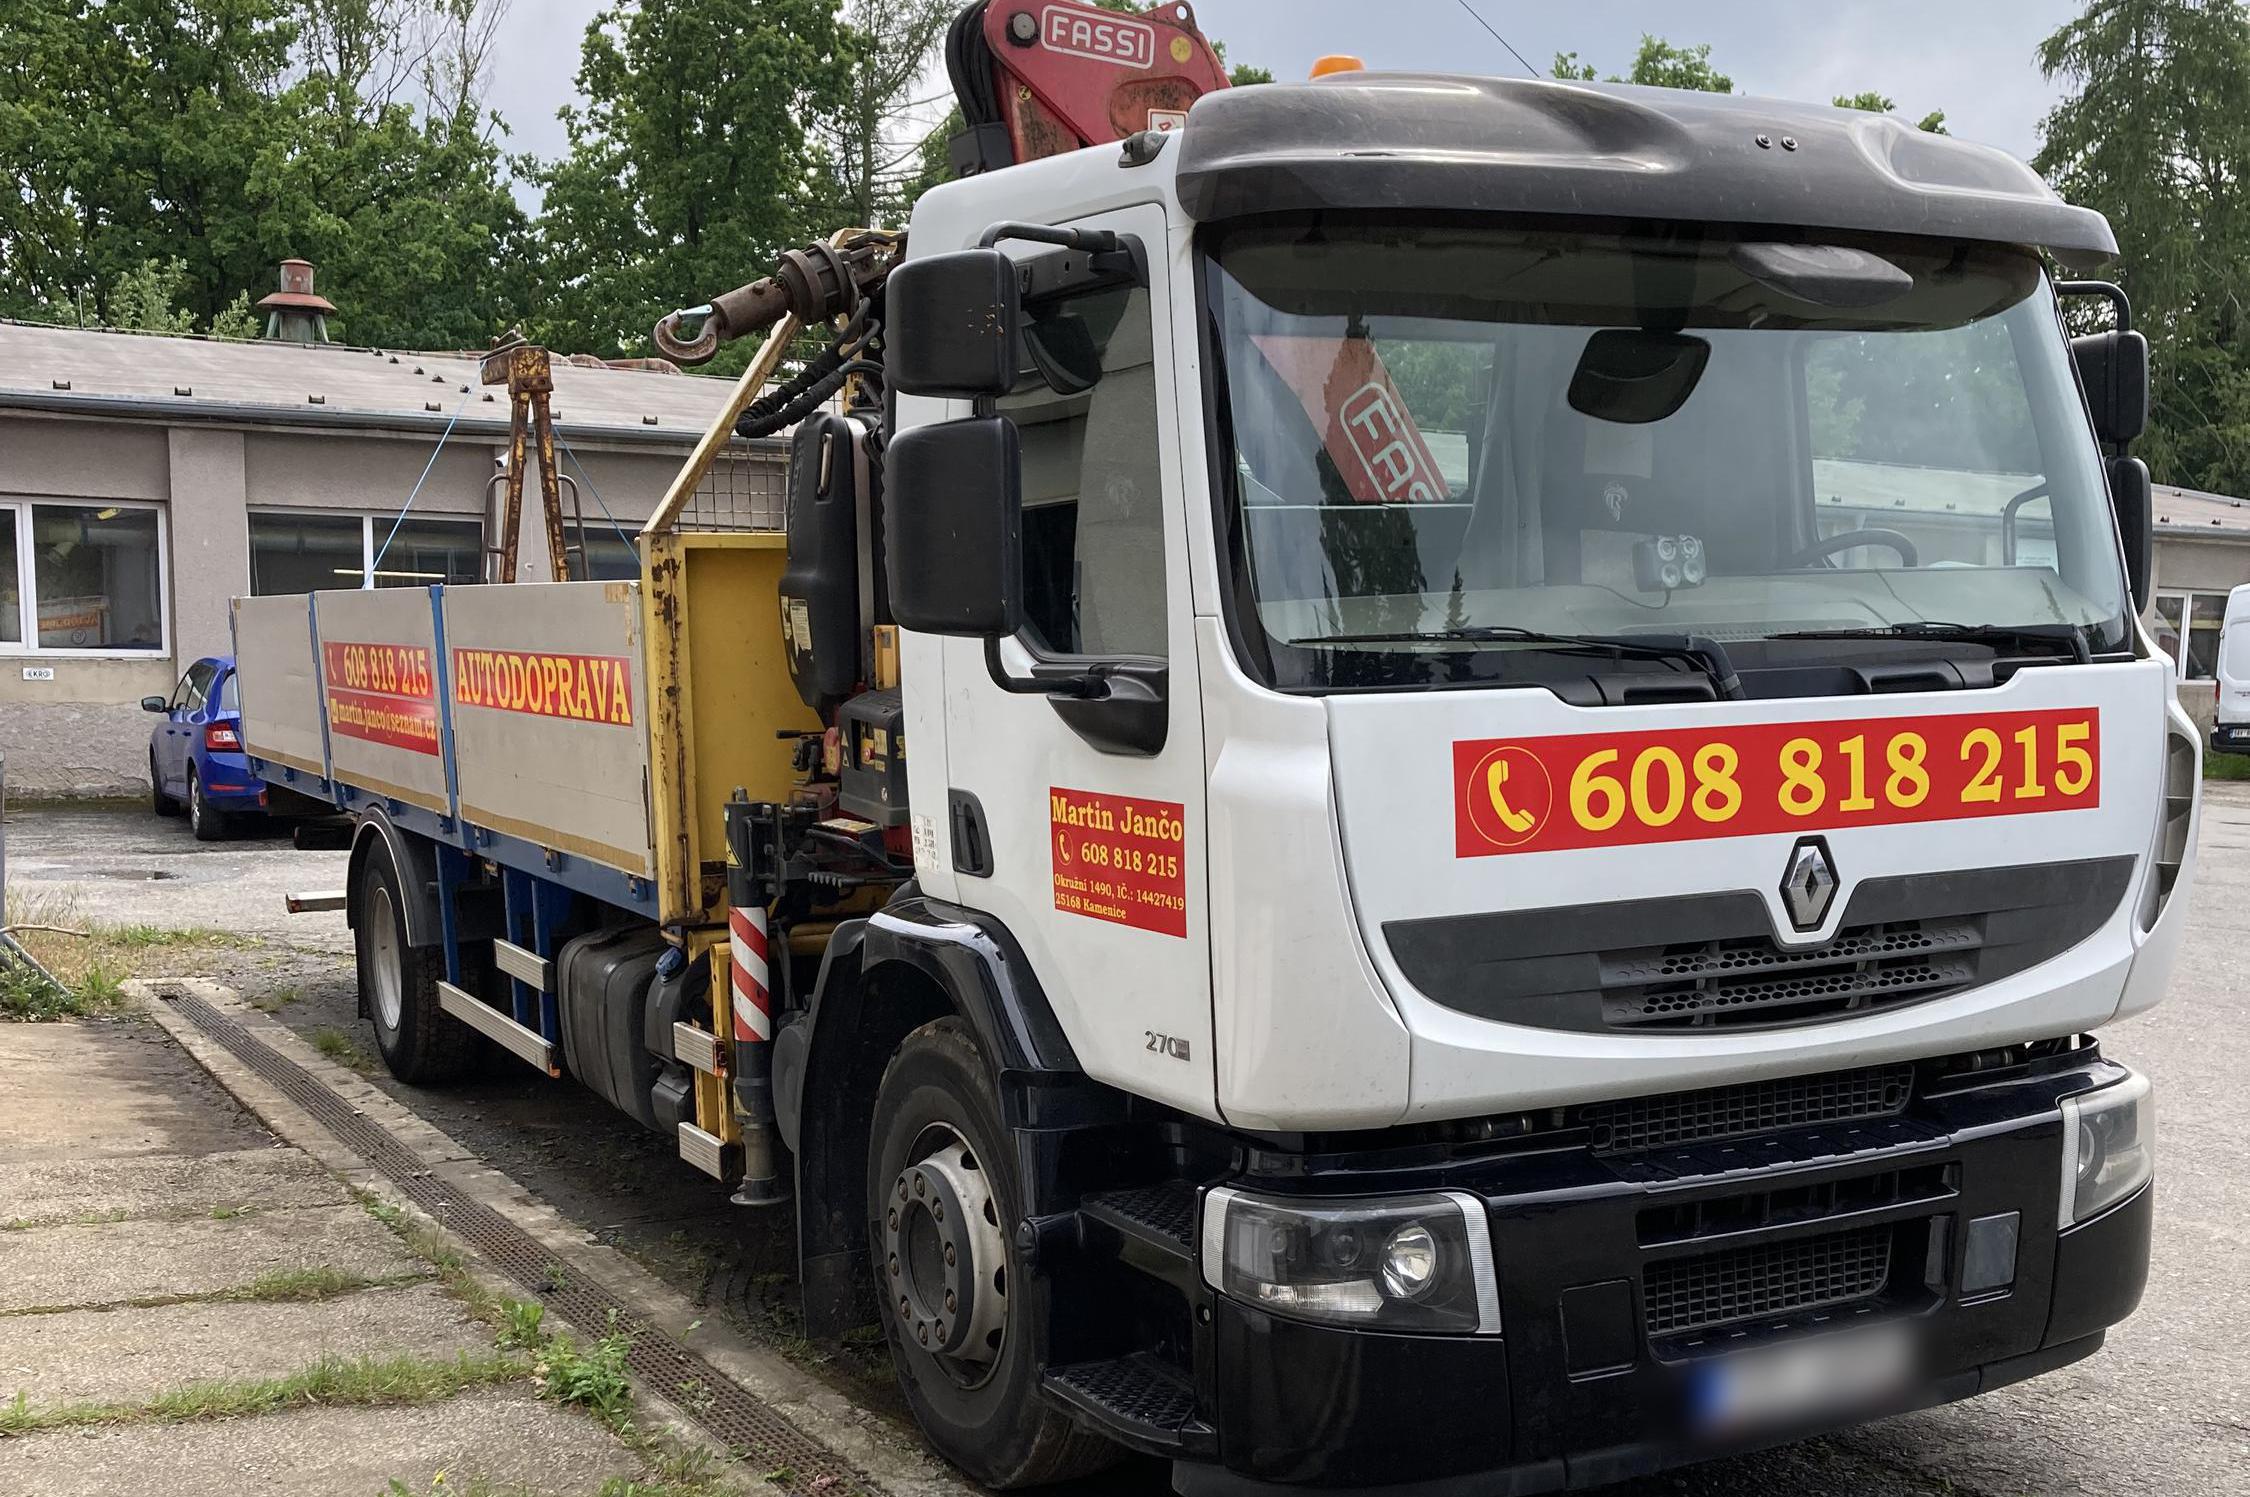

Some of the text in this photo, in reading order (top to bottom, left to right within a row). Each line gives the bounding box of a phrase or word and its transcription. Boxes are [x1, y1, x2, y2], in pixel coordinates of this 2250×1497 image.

[1051, 15, 1145, 60] FASSI
[344, 645, 428, 696] 608 818 215
[457, 651, 631, 724] AUTODOPRAVA
[339, 701, 436, 741] martin.janco@seznam.cz
[1569, 720, 2094, 831] 608 818 215
[1051, 795, 1183, 842] Martin Jančo
[1081, 842, 1177, 878] 608 818 215
[1054, 873, 1088, 892] Okružní
[1090, 880, 1115, 899] 1490,
[1136, 889, 1185, 911] 14427419
[1055, 892, 1127, 919] 25168 Kamenice
[1145, 1031, 1177, 1058] 270
